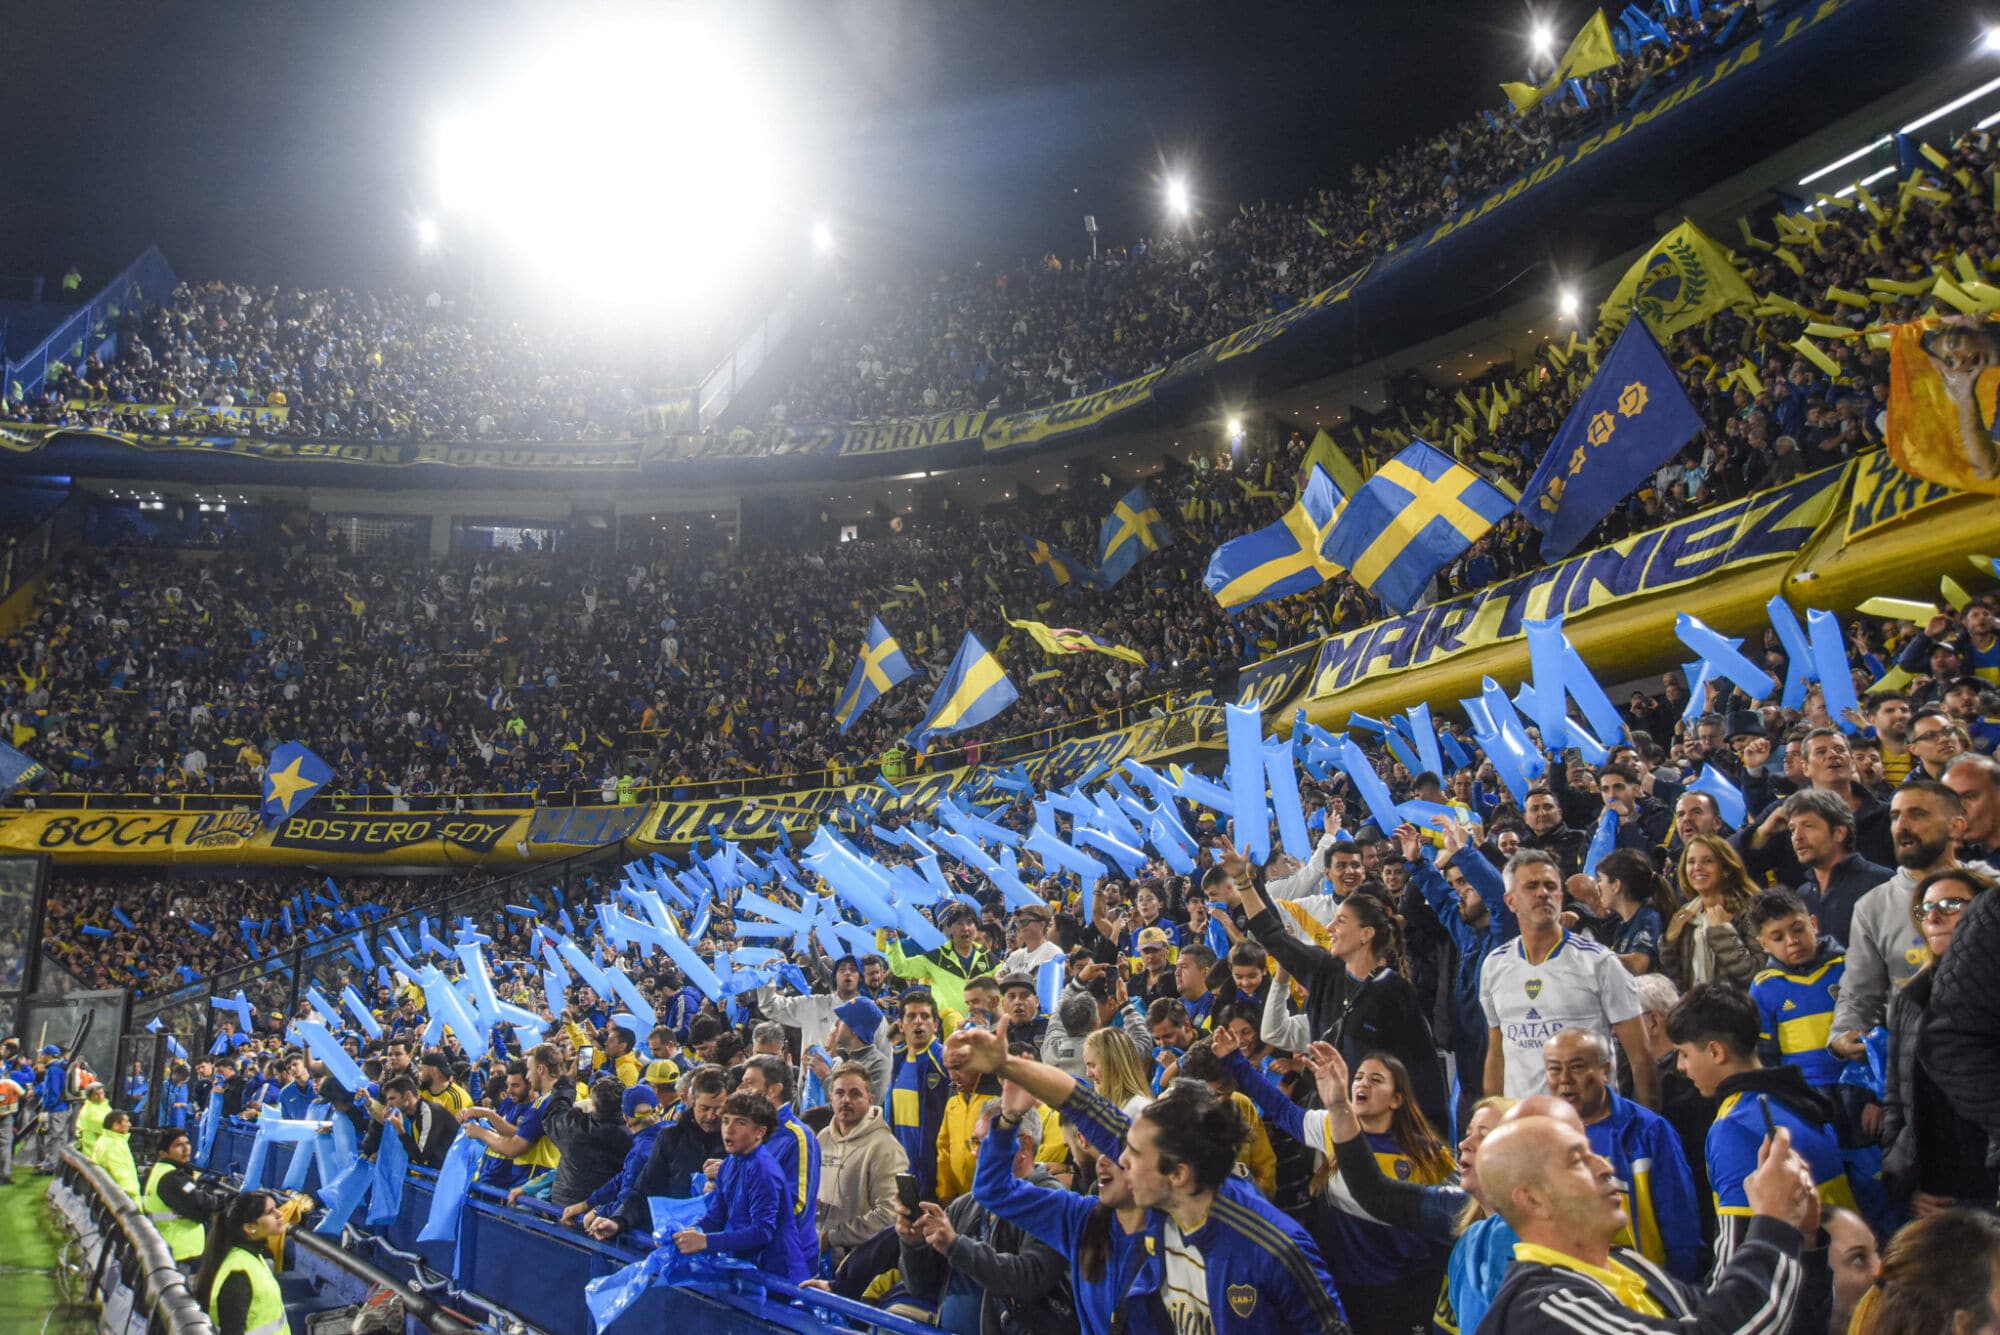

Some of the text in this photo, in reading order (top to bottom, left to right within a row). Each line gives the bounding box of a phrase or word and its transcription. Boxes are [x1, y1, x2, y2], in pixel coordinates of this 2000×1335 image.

[843, 412, 985, 453] BERNAL
[1308, 464, 1846, 697] MARTINEZ
[39, 815, 180, 847] BOCA
[284, 817, 431, 843] BOSTERO
[437, 822, 506, 843] SOY
[1507, 1022, 1564, 1042] QATAR
[1518, 1039, 1546, 1049] AIRW
